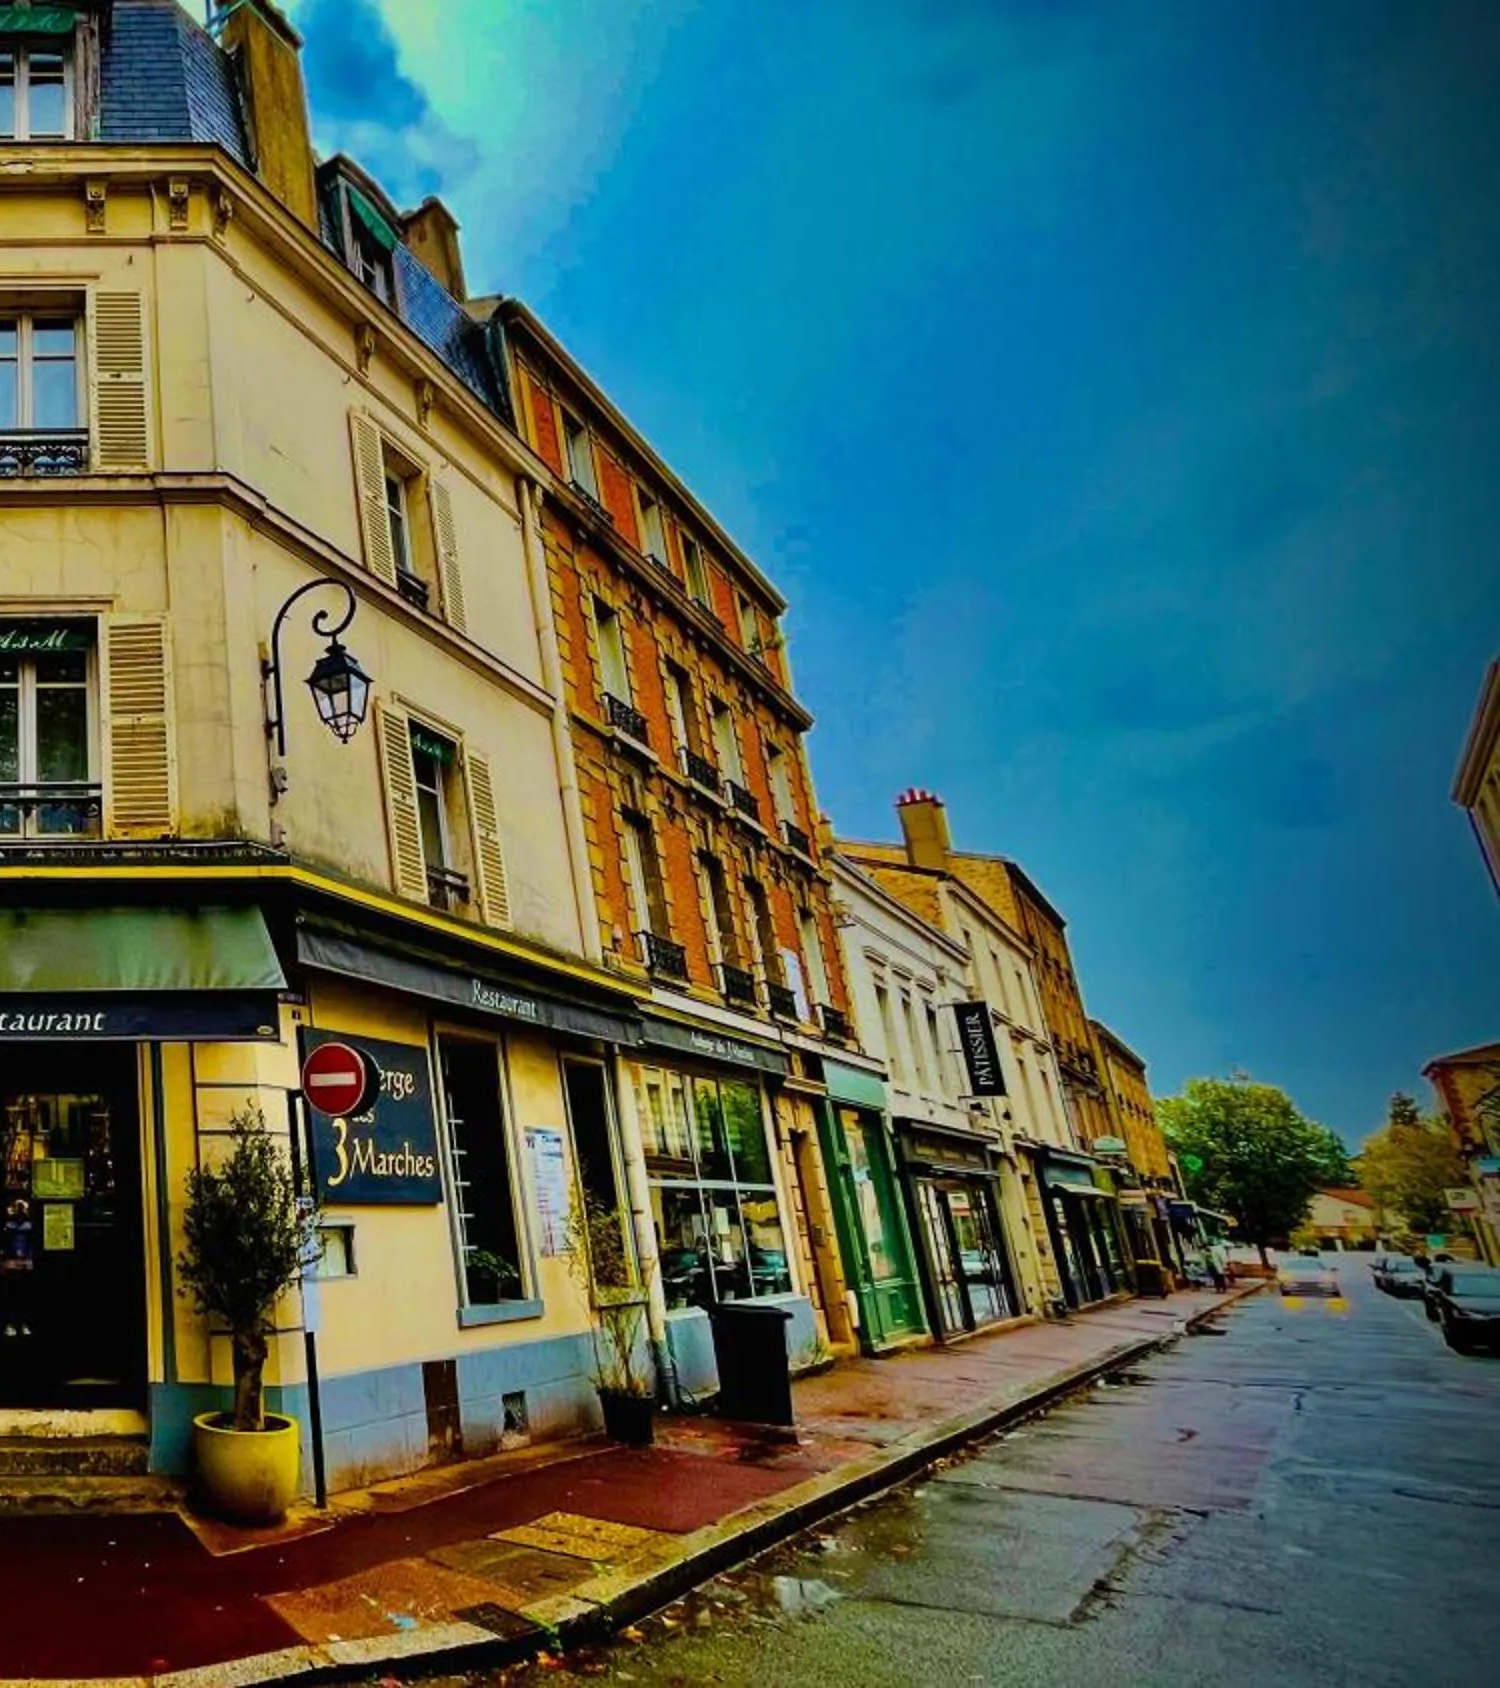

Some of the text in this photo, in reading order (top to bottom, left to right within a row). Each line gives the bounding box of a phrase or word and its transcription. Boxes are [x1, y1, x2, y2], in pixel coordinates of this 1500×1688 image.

[472, 979, 538, 1018] Restaurant
[965, 1012, 995, 1085] PÂTISSIER
[327, 1117, 435, 1187] 3 Marches
